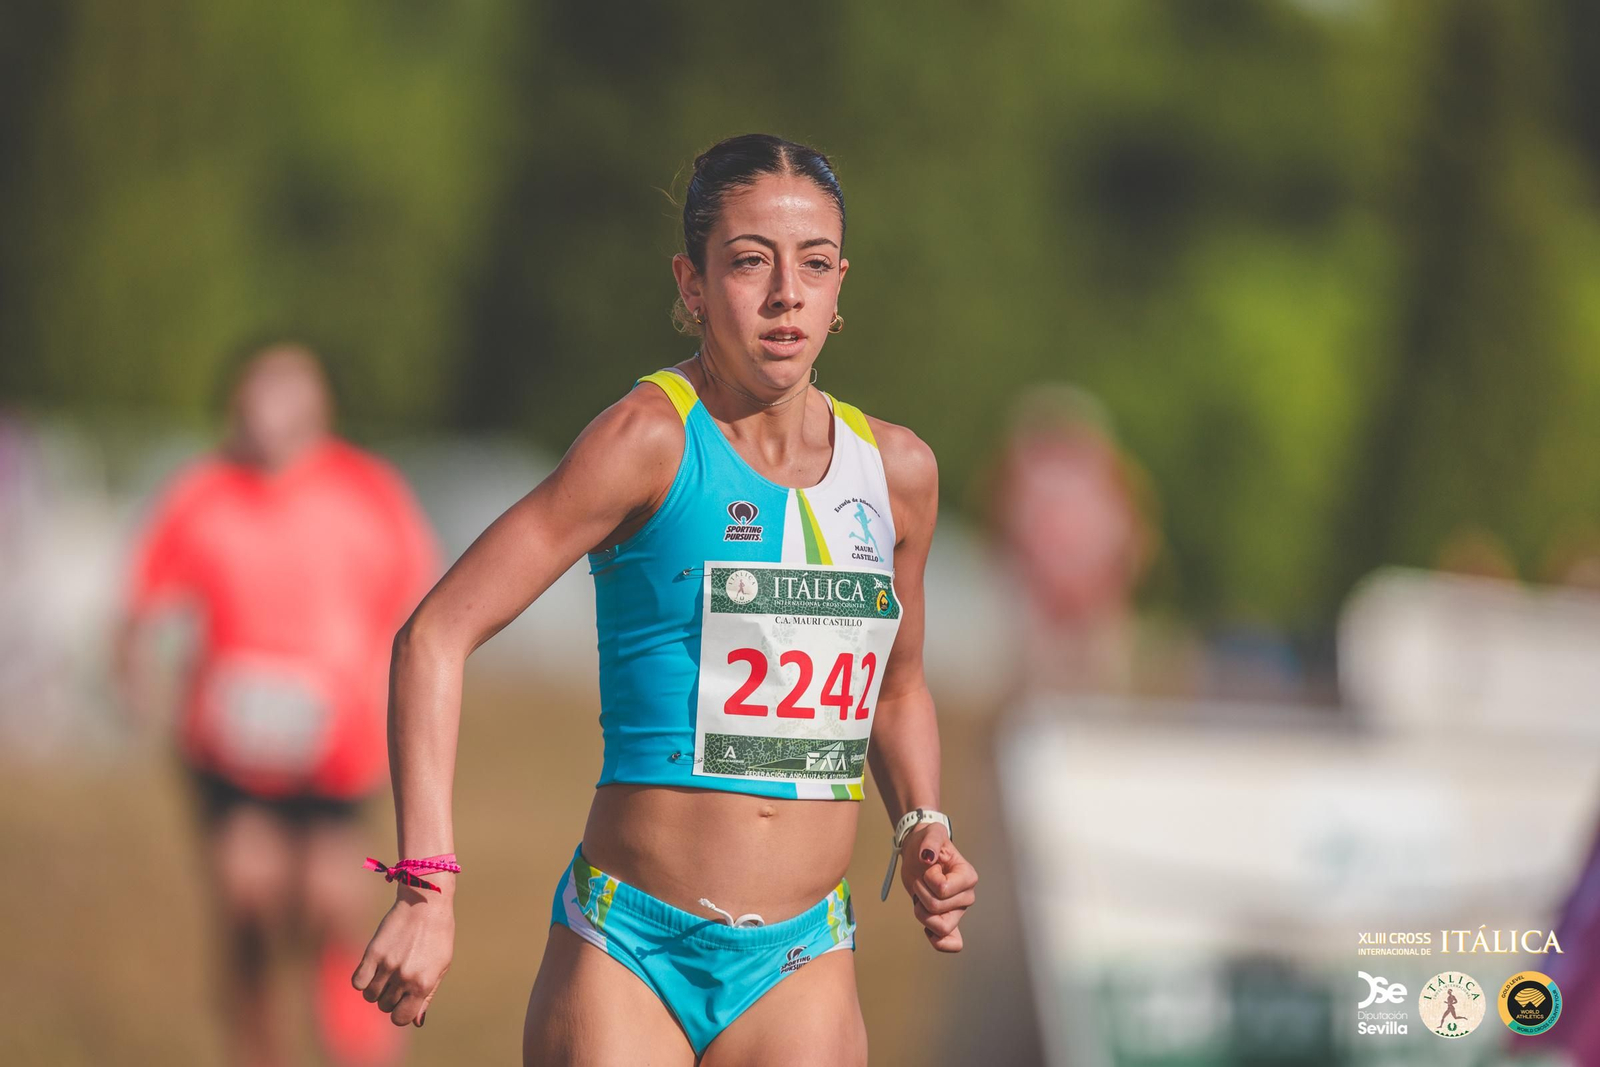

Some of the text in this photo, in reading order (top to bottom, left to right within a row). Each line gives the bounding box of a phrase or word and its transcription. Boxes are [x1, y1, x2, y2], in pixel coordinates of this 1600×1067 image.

[726, 525, 763, 534] SPORTING
[854, 545, 874, 554] MAURI
[851, 552, 879, 563] CASTILLO
[773, 572, 866, 602] ITÁLICA
[775, 616, 863, 627] C.A. MAURI CASTILLO
[723, 647, 877, 721] 2242
[745, 769, 788, 779] FEDERACIÓN
[789, 772, 822, 780] ANDALUZA
